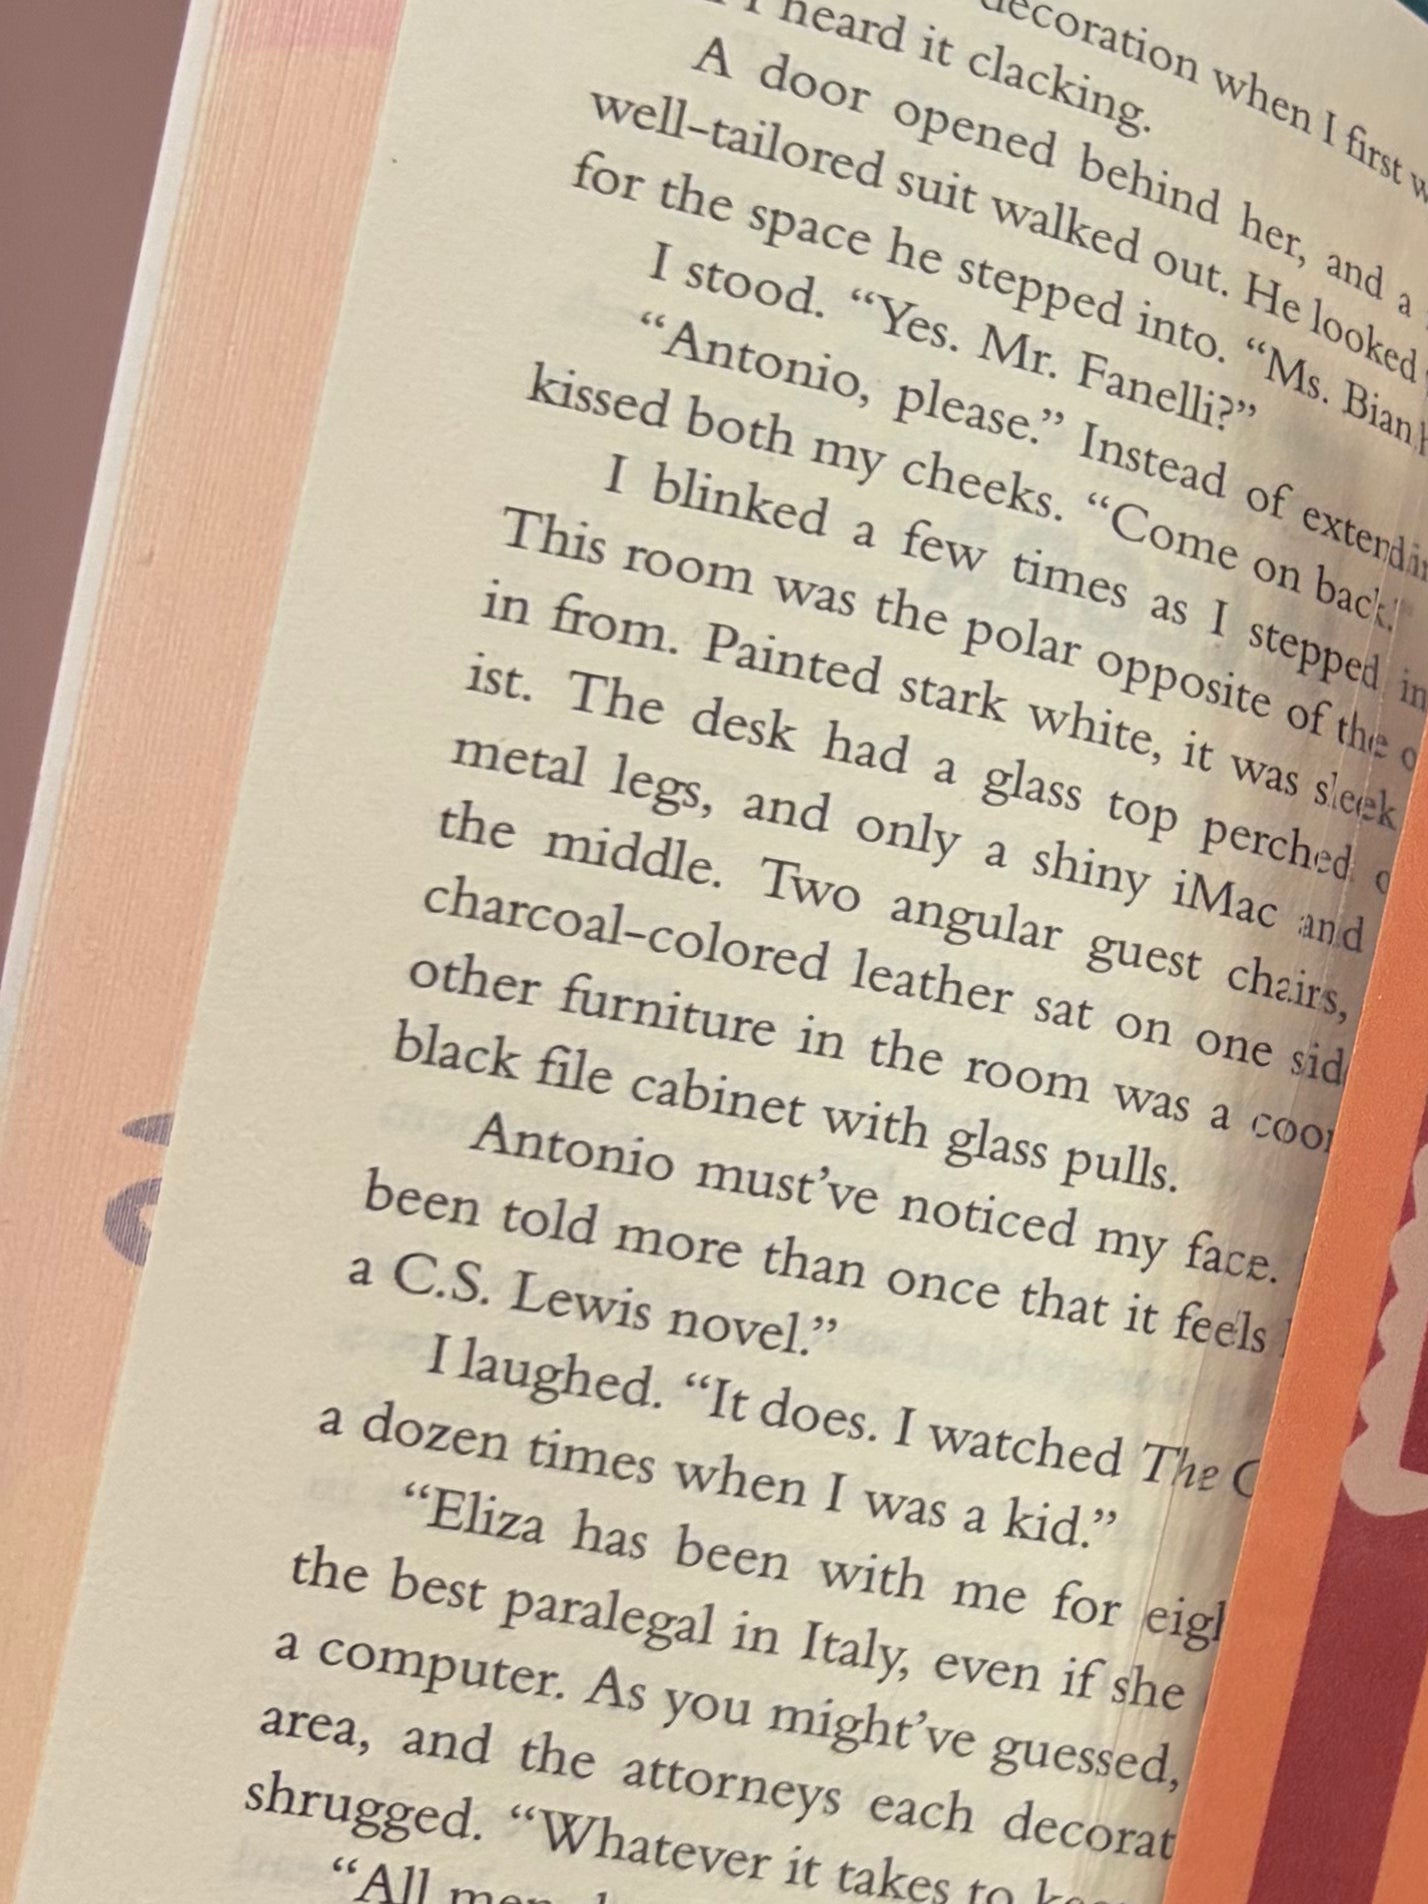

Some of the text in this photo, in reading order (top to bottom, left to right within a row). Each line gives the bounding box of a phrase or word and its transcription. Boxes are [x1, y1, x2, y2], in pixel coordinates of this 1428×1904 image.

[919, 24, 955, 67] it
[968, 44, 1151, 139] clacking.
[649, 240, 1257, 432] I stood. “Yes. Mr. Fanelli?”
[526, 360, 1301, 594] kissed both my cheeks. “Come on
[503, 505, 1333, 737] This room was the polar opposite of
[439, 799, 1348, 1025] the middle. Two angular guest chairs,
[394, 1017, 1177, 1193] black file cabinet with glass pulls.
[349, 1254, 839, 1358] a C.S. Lewis novel.”
[318, 1400, 1117, 1549] a dozen times when I was a kid.”
[292, 1543, 1185, 1711] the best paralegal in Italy, even if she
[244, 1769, 482, 1844] shrugged.
[510, 1804, 773, 1880] “Whatever
[784, 1845, 822, 1889] it
